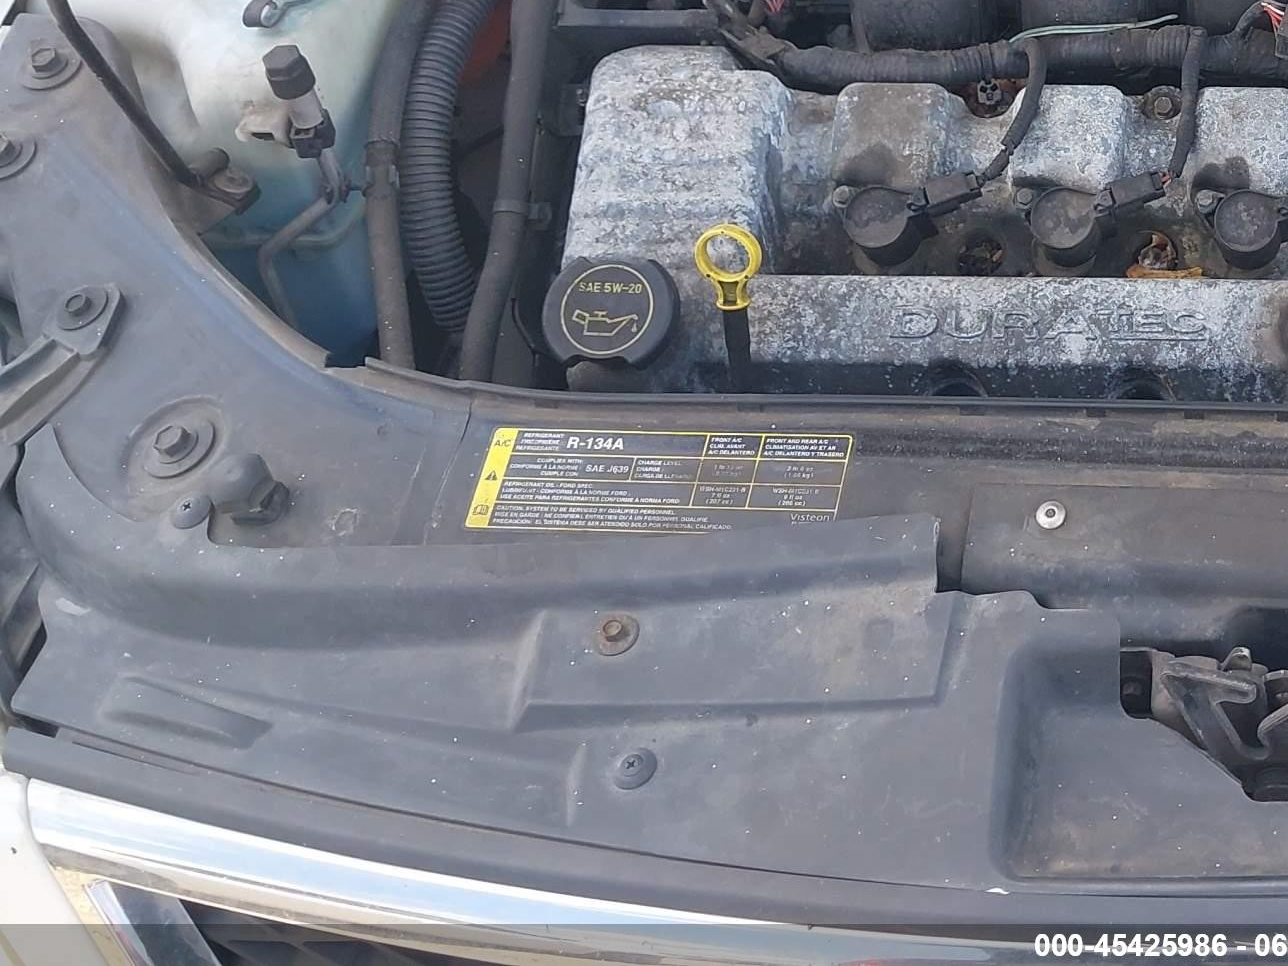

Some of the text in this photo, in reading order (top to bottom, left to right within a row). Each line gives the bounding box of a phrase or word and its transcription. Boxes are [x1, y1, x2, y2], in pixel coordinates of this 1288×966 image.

[579, 282, 642, 294] SAE 5W-20
[891, 305, 1208, 341] DURATEC
[494, 439, 512, 447] A/C
[566, 436, 624, 450] R-134A
[607, 466, 629, 474] J639
[790, 514, 830, 522] Visteon
